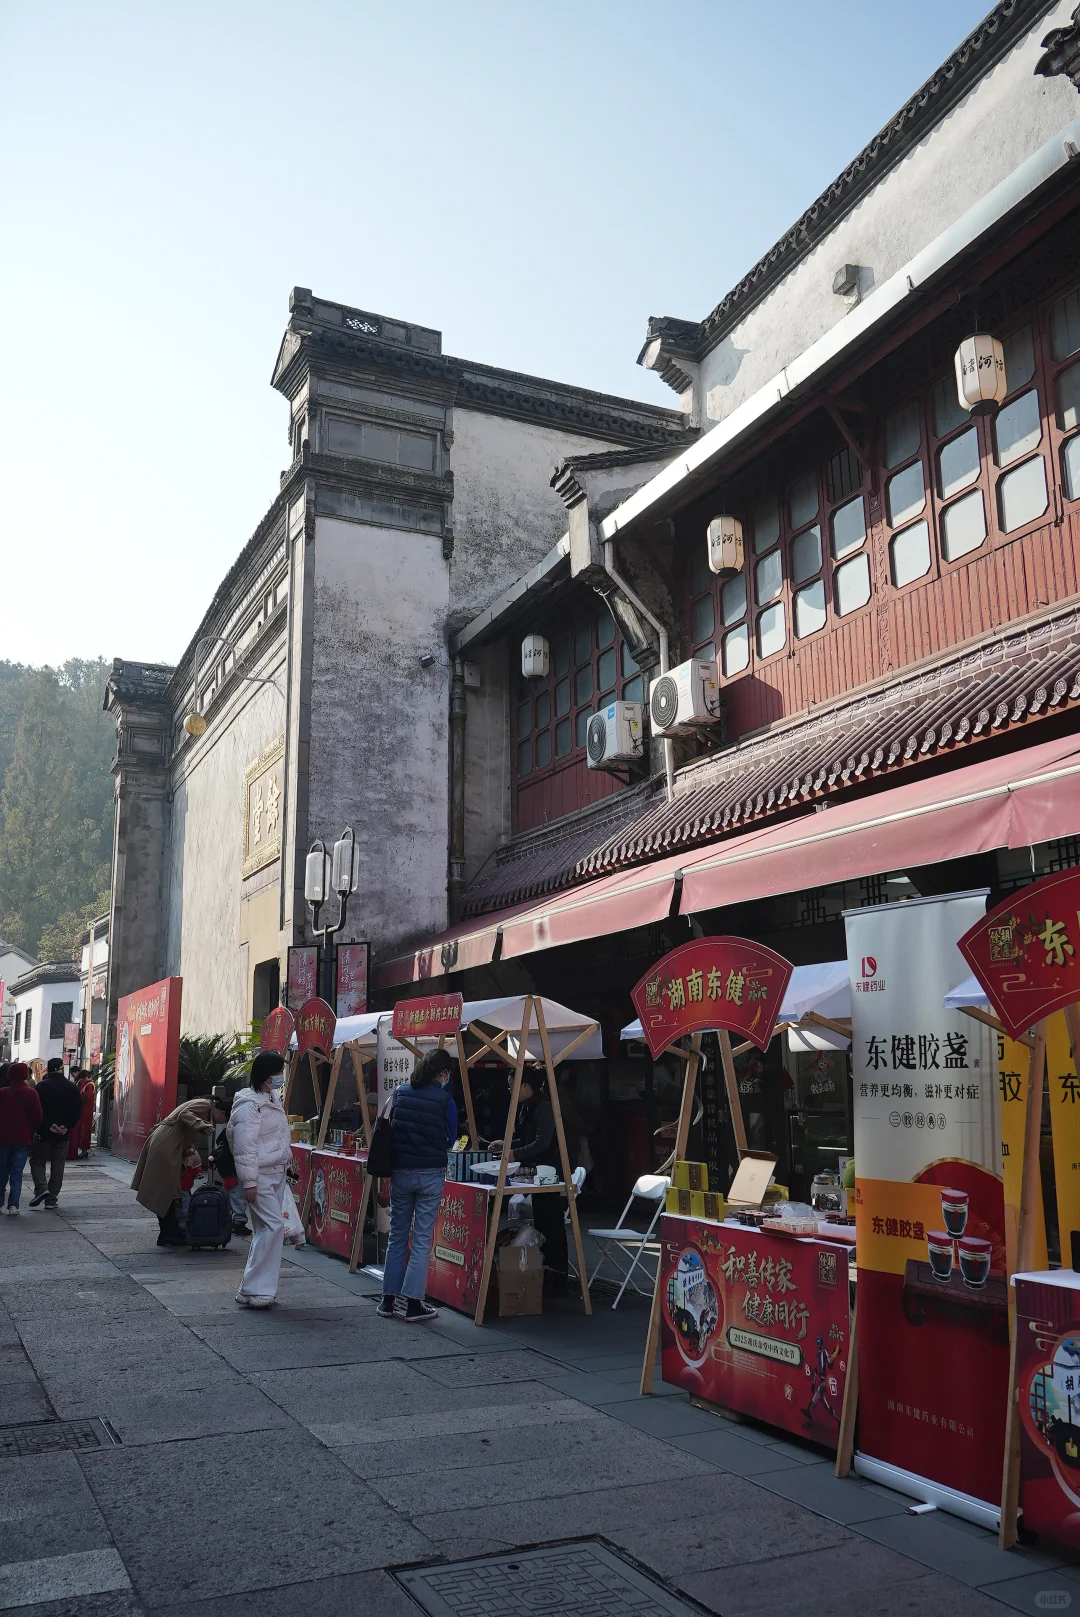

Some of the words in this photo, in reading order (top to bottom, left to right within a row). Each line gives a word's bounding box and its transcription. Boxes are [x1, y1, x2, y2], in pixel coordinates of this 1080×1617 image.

[962, 355, 1004, 376] 清河坊
[1038, 914, 1080, 966] 东
[667, 965, 745, 1011] 湖南东健
[855, 979, 886, 993] 东健药业
[865, 1031, 970, 1071] 东健胶盏
[889, 1111, 947, 1130] 三胶经典方
[872, 1215, 925, 1241] 东健胶盏
[721, 1245, 799, 1295] 积善传家
[741, 1290, 811, 1340] 健康同行
[1065, 1374, 1080, 1391] 胡
[887, 1399, 974, 1439] 湖南东健药业有限公司
